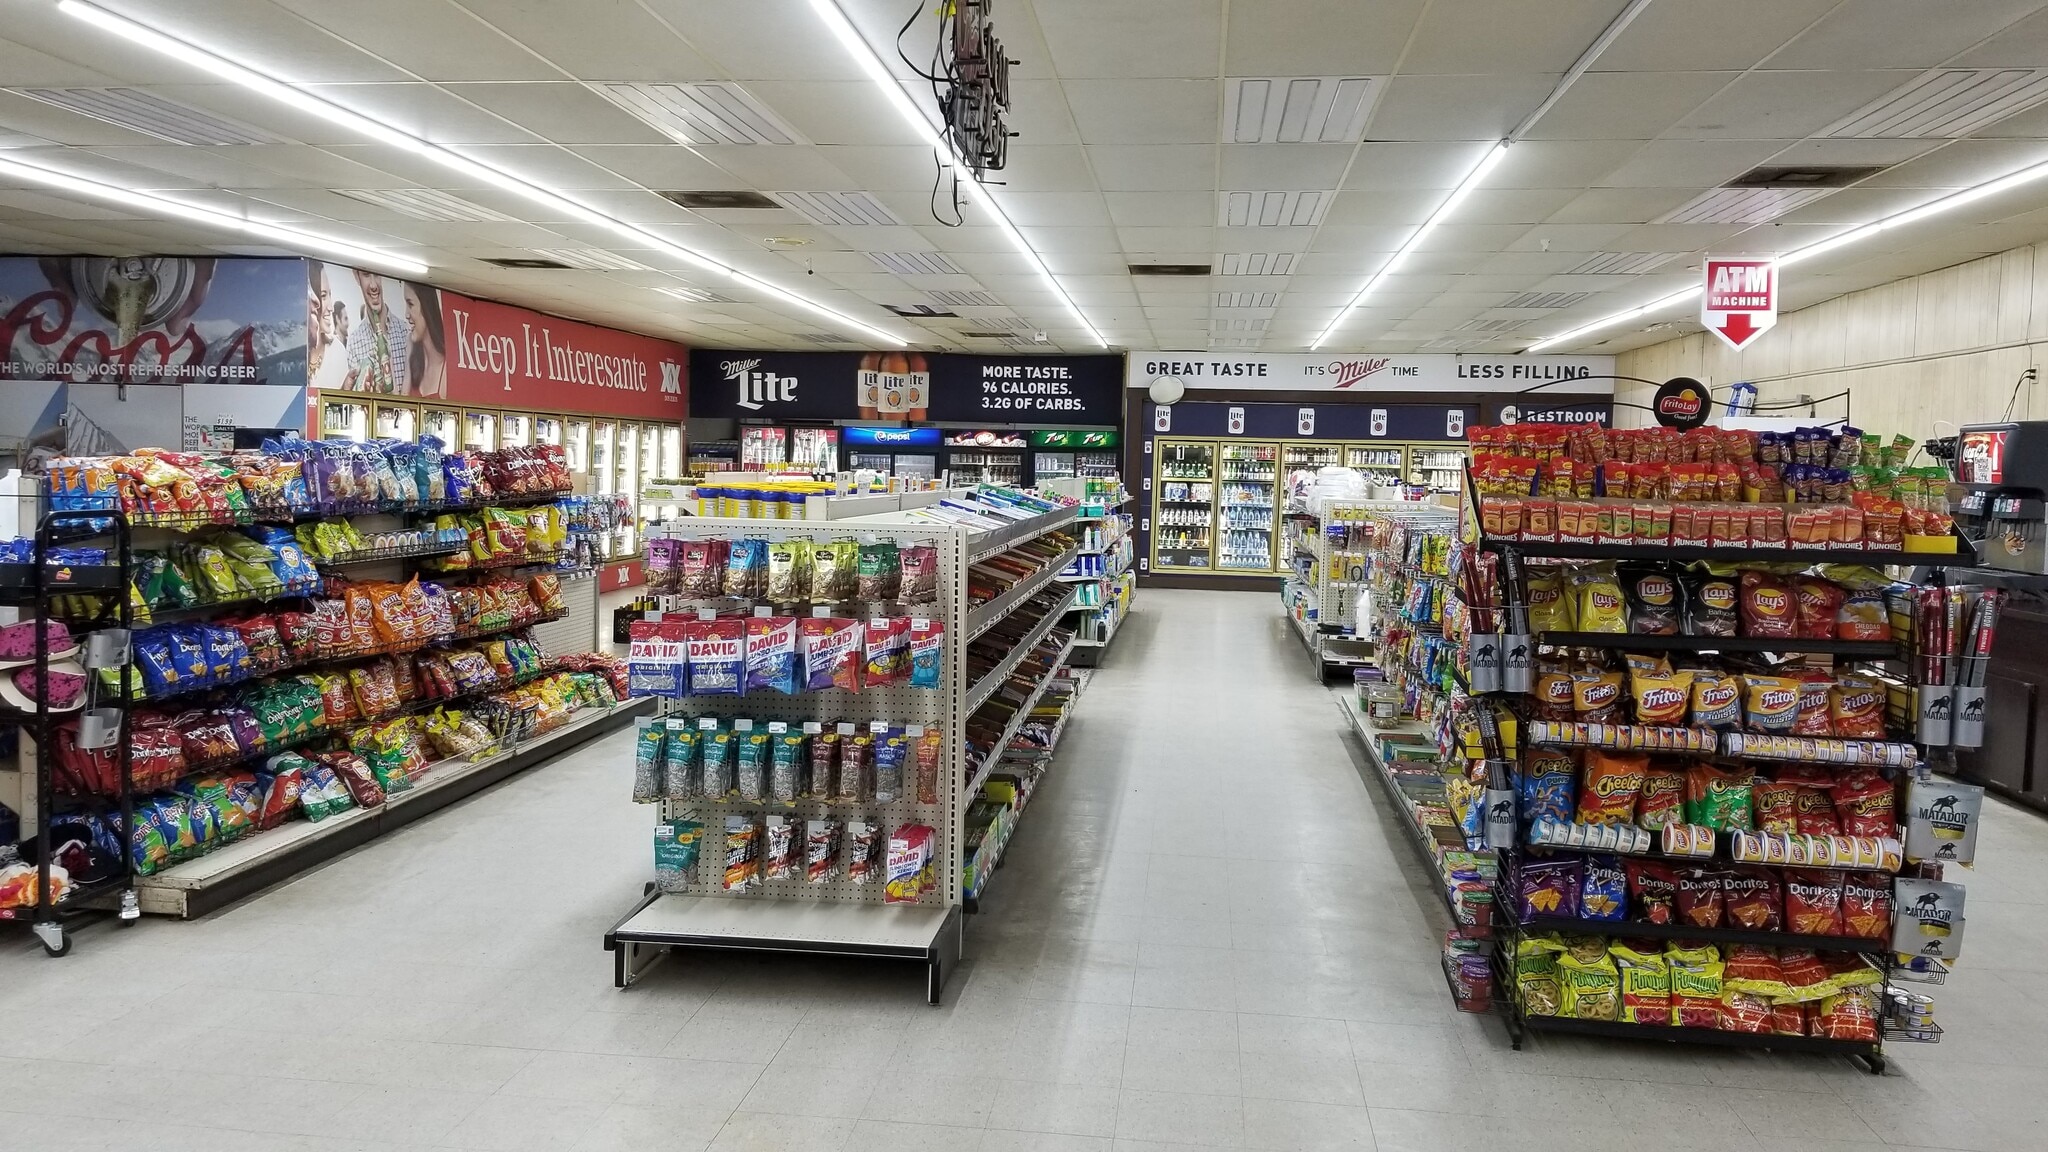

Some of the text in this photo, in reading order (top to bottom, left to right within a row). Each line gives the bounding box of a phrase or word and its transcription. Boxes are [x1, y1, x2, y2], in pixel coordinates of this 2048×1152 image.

[1713, 266, 1768, 293] ATM
[1712, 296, 1767, 306] MACHINE
[452, 309, 648, 393] Keep It Interesante
[22, 361, 83, 376] WORLD'S
[86, 362, 125, 377] MOST
[129, 363, 217, 379] REFRESHING
[221, 365, 256, 379] BEER
[720, 358, 763, 380] Miller
[982, 365, 1073, 379] MORE TASTE.
[1146, 361, 1268, 377] GREAT TASTE
[1304, 357, 1419, 389] IT'S Miller TIME
[1458, 364, 1590, 379] LESS FILLING
[864, 372, 879, 386] Lit
[883, 375, 905, 391] Lite
[909, 373, 924, 385] ite
[736, 370, 799, 411] Lite
[982, 381, 1073, 395] 96 CALORIES.
[981, 397, 1086, 411] 3.2G OF CARBS.
[1527, 410, 1607, 423] RESTROOM
[886, 431, 911, 441] pepsi
[1485, 532, 1518, 542] MUNCHIES
[1522, 533, 1555, 543] MUNCHIES
[1560, 534, 1594, 545] MUNCHIES
[1599, 536, 1633, 546] MUNCHIES
[1635, 536, 1669, 546] MUNCHIES
[1673, 537, 1708, 548] MUNCHIES
[1713, 538, 1748, 549] MUNCHIES
[1752, 539, 1787, 549] MUNCHIES
[1791, 540, 1827, 551] MUNCHIES
[1828, 540, 1863, 550] MUNCHIES
[1867, 540, 1902, 551] MUNCHIES
[1529, 586, 1559, 604] Lay's
[1638, 578, 1674, 600] Lay's
[1704, 585, 1736, 601] Lay's
[1592, 592, 1618, 609] Lay's
[1755, 592, 1786, 610] Lay's
[1800, 591, 1826, 606] ay's
[690, 642, 738, 657] DAVID
[748, 631, 789, 653] DAVID
[809, 631, 853, 654] DAVID
[911, 638, 937, 650] DAVID
[632, 643, 678, 657] DAVID
[809, 649, 835, 662] JUMBO
[1550, 680, 1572, 697] Frit
[1703, 685, 1735, 705] Fritos
[1643, 688, 1685, 711] Fritos
[1762, 690, 1796, 709] Fritos
[1800, 692, 1828, 710] ritos
[1532, 757, 1576, 780] Cheetos
[1596, 772, 1643, 798] Cheetos
[1642, 773, 1684, 798] Cheetos
[1488, 815, 1514, 824] MATADO
[1918, 806, 1969, 824] MATADOR
[889, 852, 919, 865] DAVID
[1934, 852, 1957, 860] MATADOR
[1584, 864, 1627, 882] Doritos
[1638, 876, 1676, 891] Doritos
[1724, 877, 1769, 891] Doritos
[1790, 883, 1841, 899] Doritos
[1845, 884, 1890, 899] Doritos
[1905, 907, 1953, 921] MATADOR
[1631, 970, 1671, 991] FUNYUN
